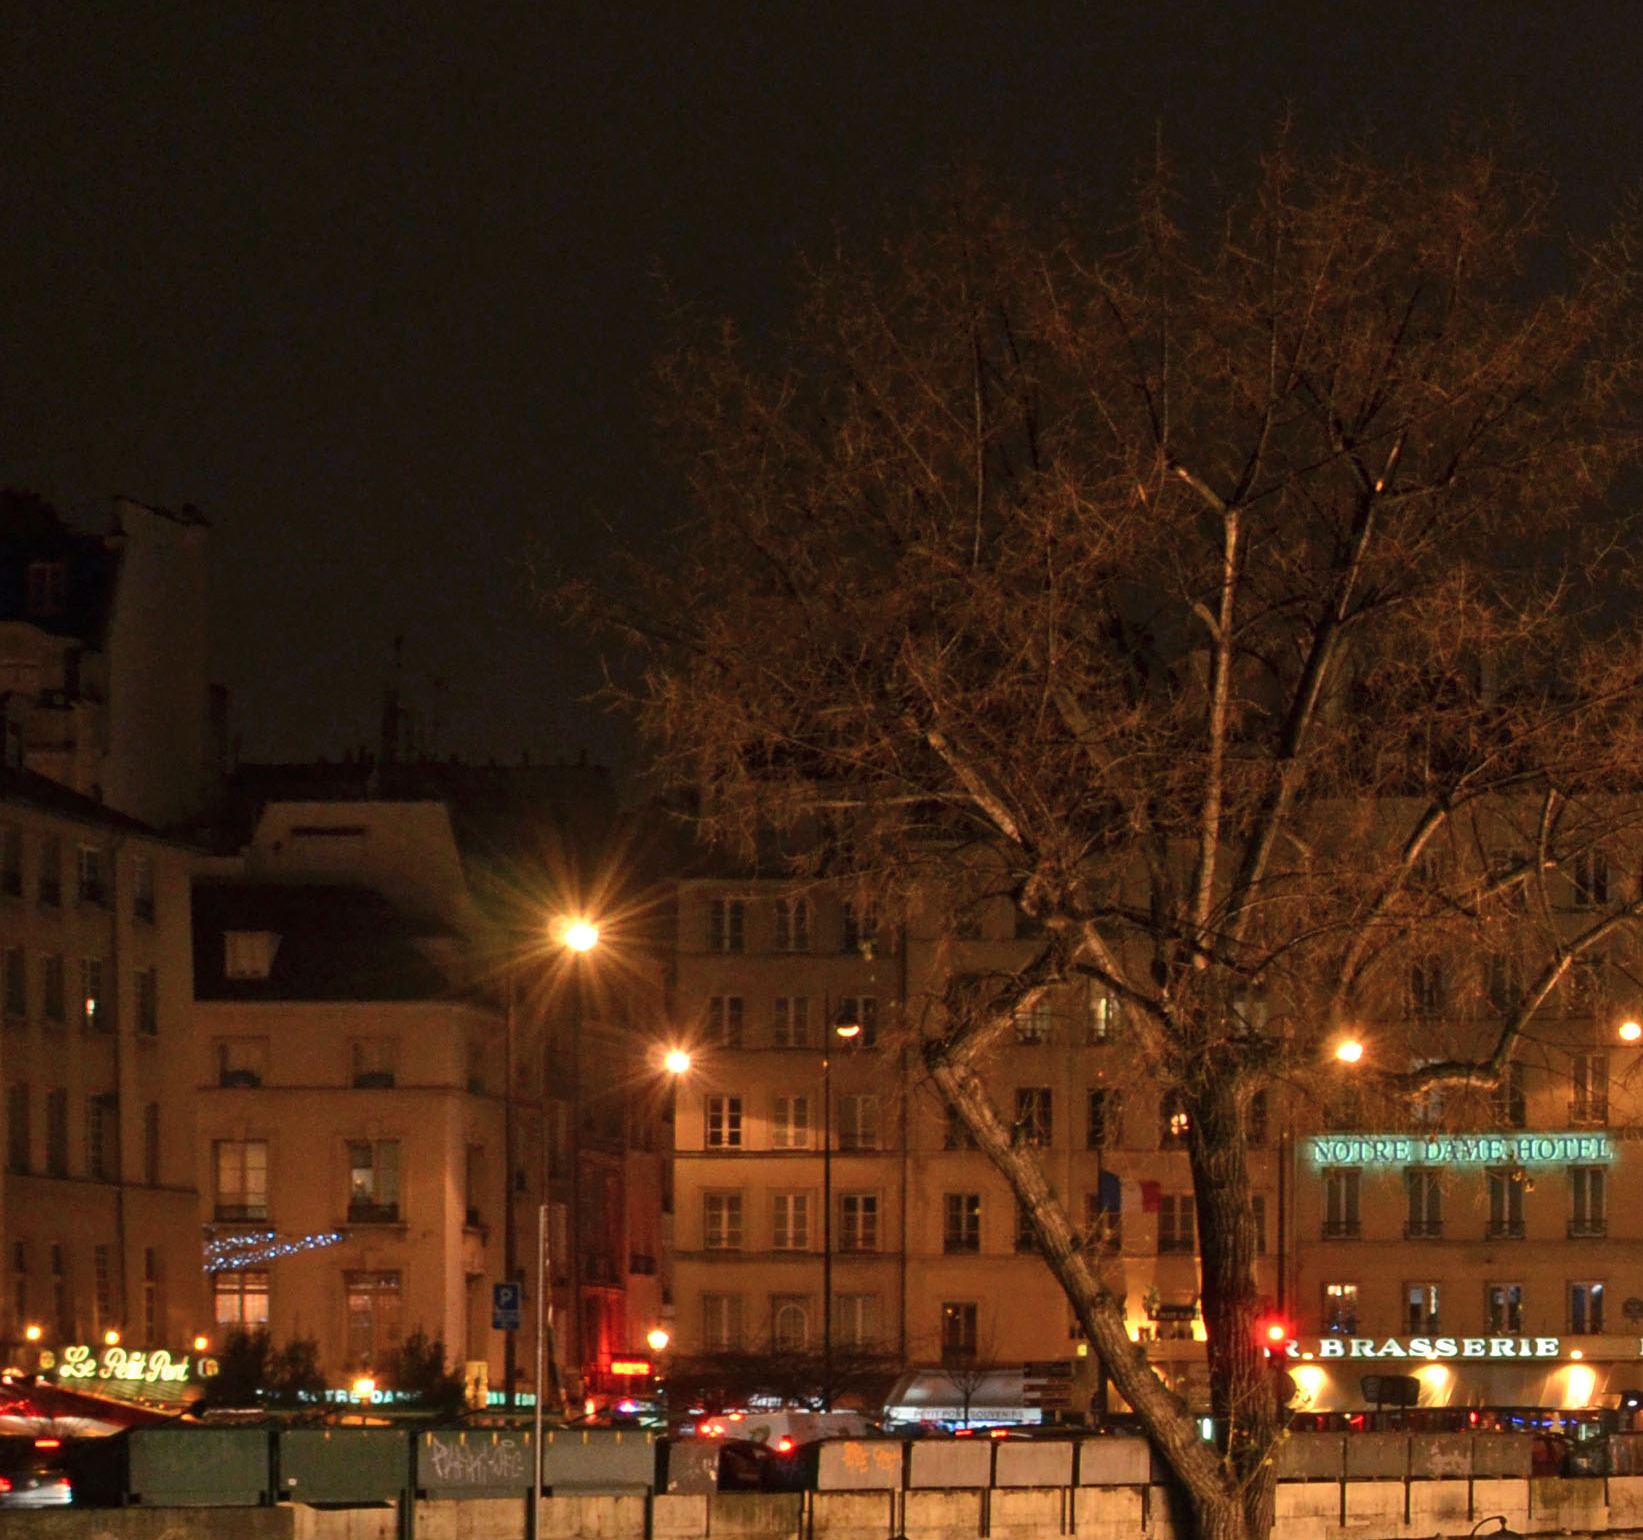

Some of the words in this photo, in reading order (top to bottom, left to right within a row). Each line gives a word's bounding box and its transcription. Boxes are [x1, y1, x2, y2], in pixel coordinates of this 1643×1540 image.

[1313, 1138, 1412, 1163] NOTRE
[1423, 1138, 1508, 1162] DAME
[1516, 1137, 1614, 1161] HOTEL
[1319, 1337, 1560, 1358] BRASSERIE
[59, 1345, 97, 1378] Le
